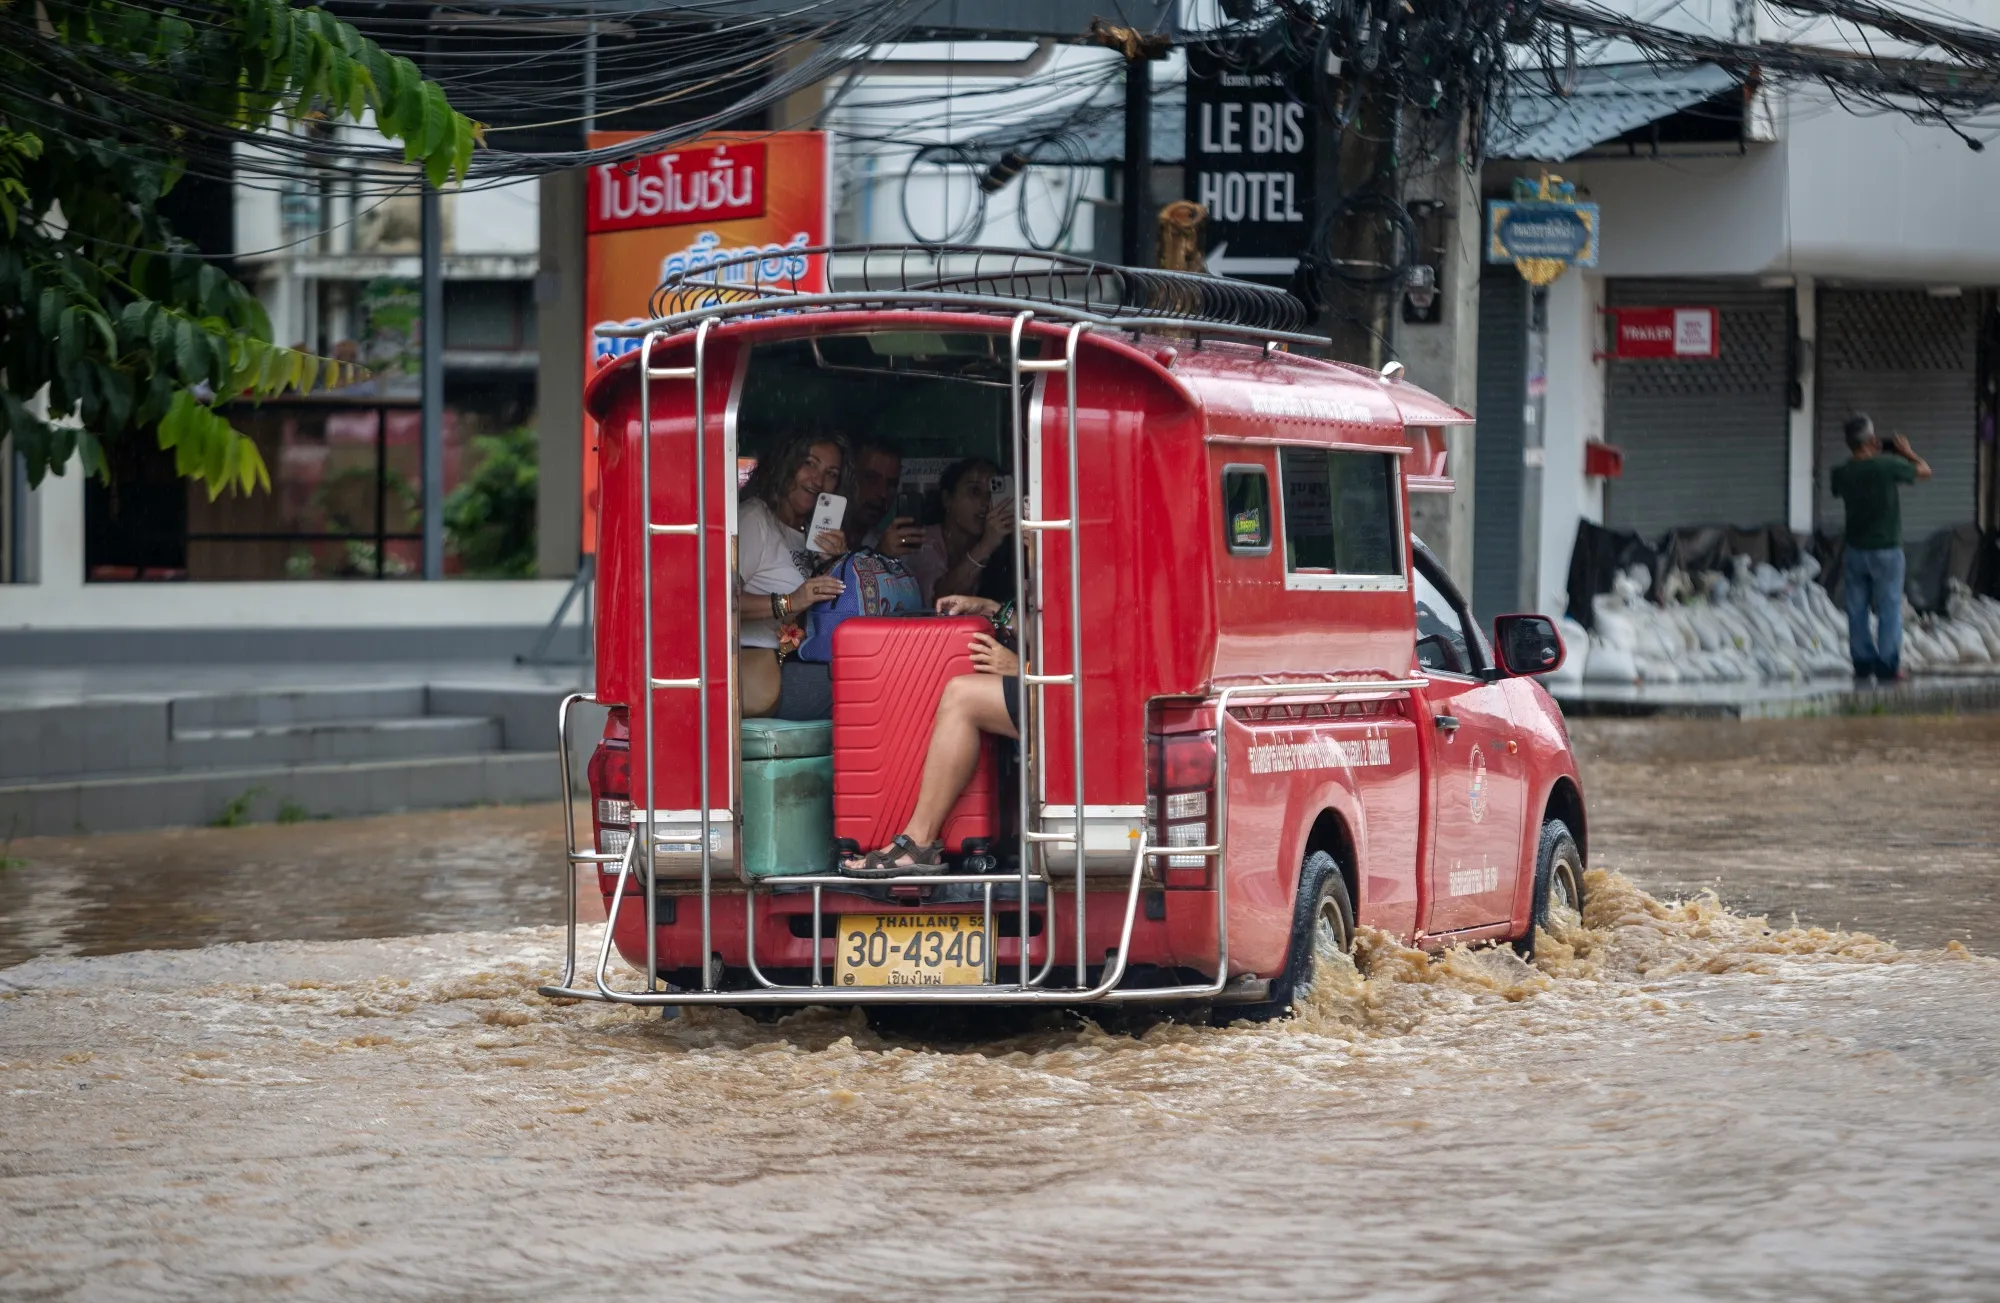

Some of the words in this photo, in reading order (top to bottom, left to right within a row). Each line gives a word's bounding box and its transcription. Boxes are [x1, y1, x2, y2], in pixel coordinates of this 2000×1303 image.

[1202, 102, 1242, 154] LE
[1252, 102, 1305, 154] BIS
[596, 145, 754, 220] โปรโมชั่น
[1200, 171, 1304, 222] HOTEL
[1622, 325, 1673, 341] TRAILER
[876, 916, 960, 928] THAILAND
[846, 930, 986, 968] 30-4340
[887, 970, 942, 985] เชียงใหม่
